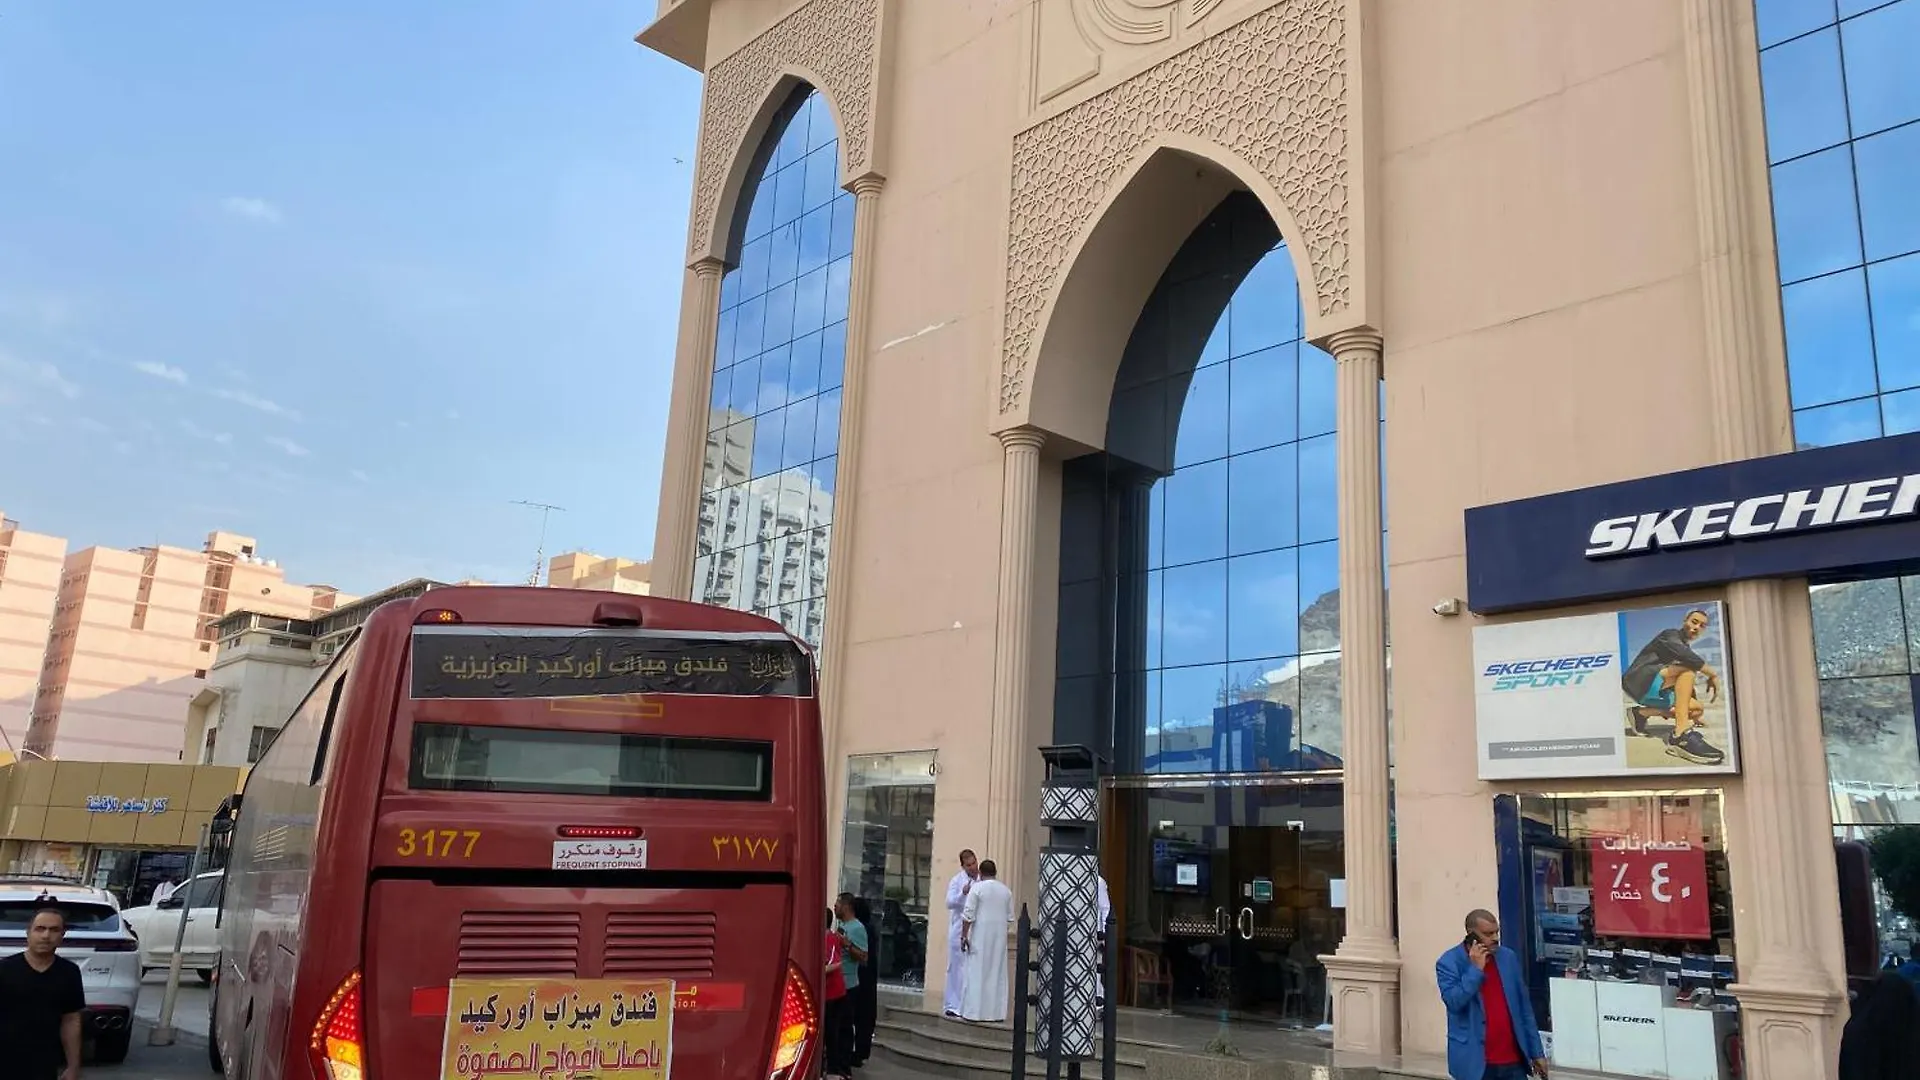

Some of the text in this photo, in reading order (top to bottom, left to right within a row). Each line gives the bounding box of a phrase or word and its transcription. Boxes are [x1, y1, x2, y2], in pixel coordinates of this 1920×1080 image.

[441, 648, 728, 680] فندق ميزاب أوركيد العزيزية
[1483, 654, 1613, 676] SKECHERS
[1492, 670, 1594, 691] SPORT
[397, 829, 482, 858] 3177
[558, 843, 643, 858] وقوف متكرر
[712, 833, 780, 861] ٣١٧٧
[1602, 832, 1692, 855] خصم ثابت
[556, 861, 600, 869] FREQUENT
[1610, 888, 1642, 901] خصم
[460, 988, 658, 1033] فندق ميزاب أوركيد
[1603, 1014, 1656, 1025] SKECHERS
[457, 1040, 662, 1080] باصات أفواج الصفوة
